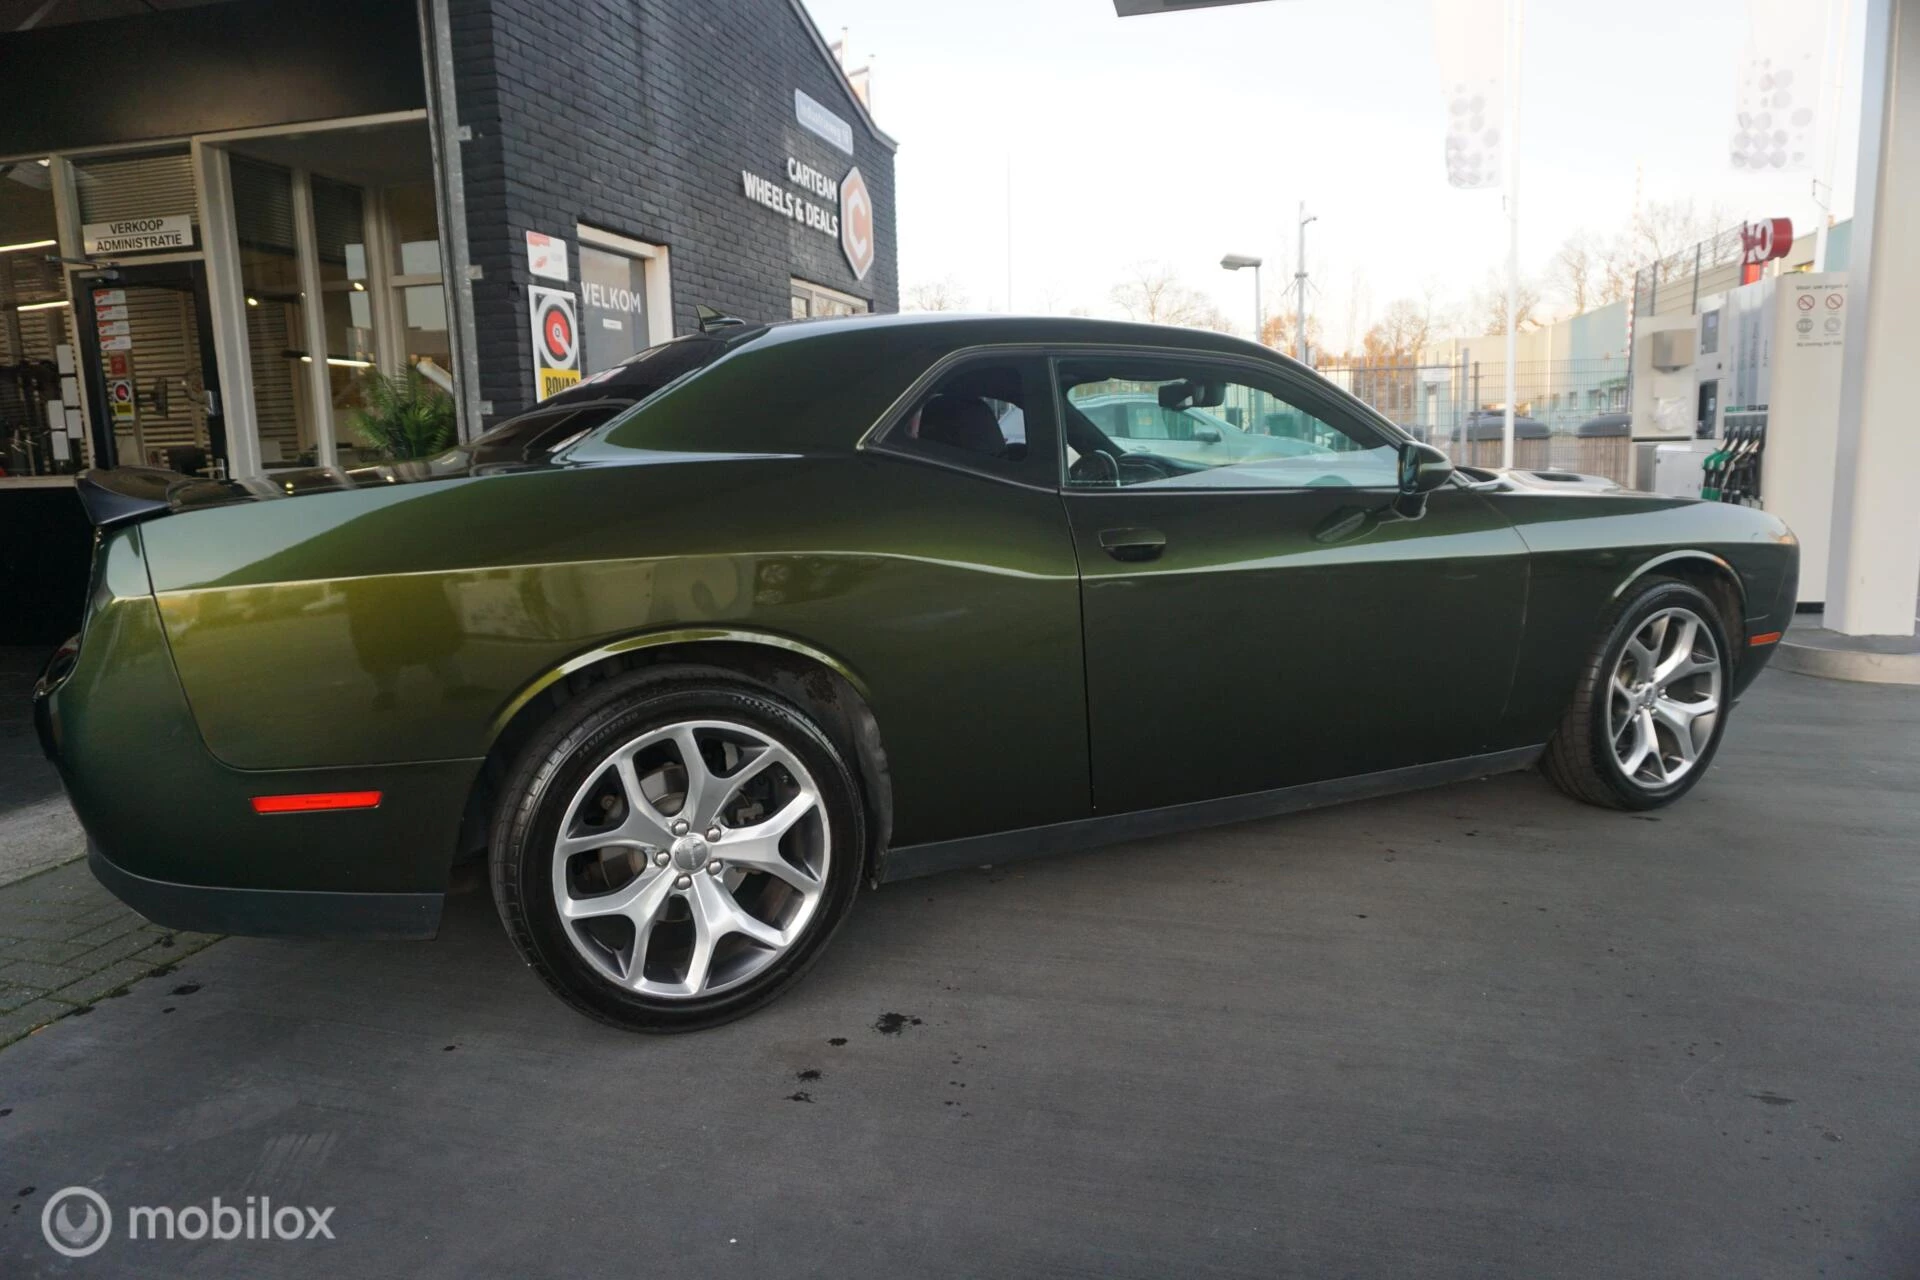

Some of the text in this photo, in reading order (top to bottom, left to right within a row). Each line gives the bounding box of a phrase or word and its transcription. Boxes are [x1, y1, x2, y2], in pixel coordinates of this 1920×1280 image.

[788, 157, 838, 202] CARTEAM
[742, 170, 839, 238] WHEELS & DEALS
[109, 219, 164, 235] VERKOOP
[96, 234, 183, 252] ADMINISTRATIE
